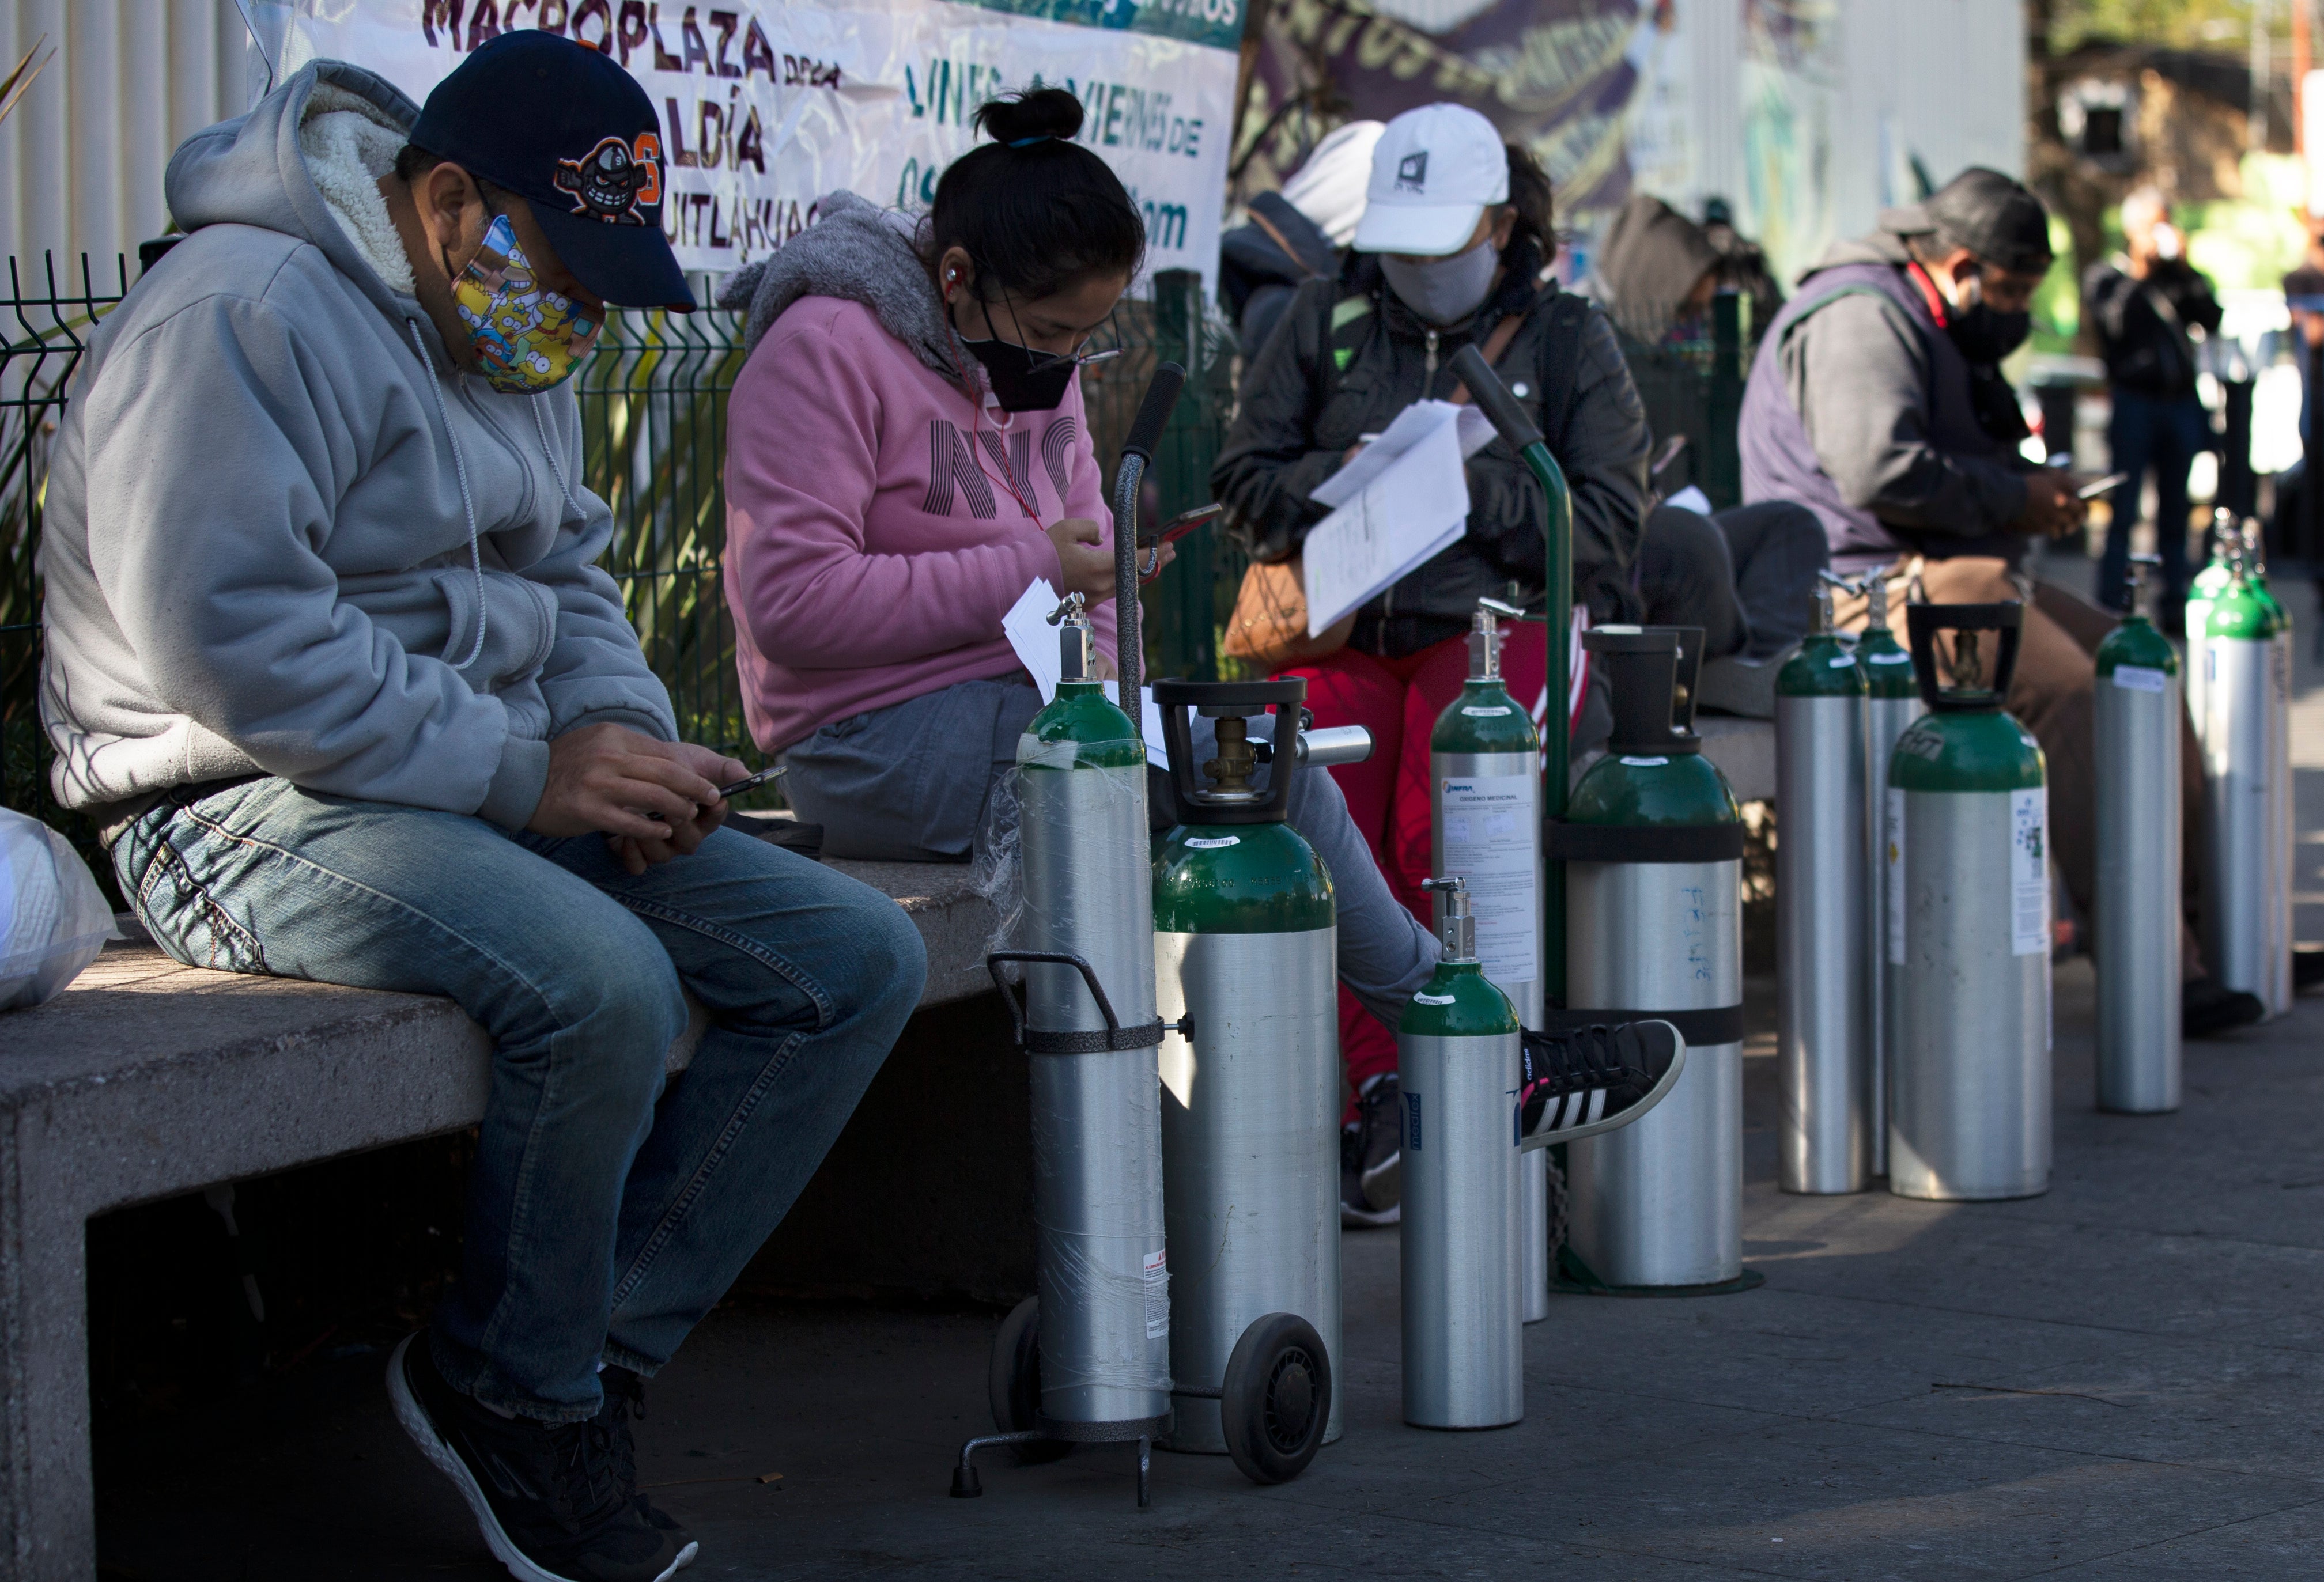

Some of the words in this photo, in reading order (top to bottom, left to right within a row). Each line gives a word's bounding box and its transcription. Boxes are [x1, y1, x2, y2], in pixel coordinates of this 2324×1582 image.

[663, 84, 765, 175] LDÍA
[1168, 117, 1203, 158] DE
[923, 415, 1076, 520] NYC
[1524, 1047, 1533, 1081] adidas
